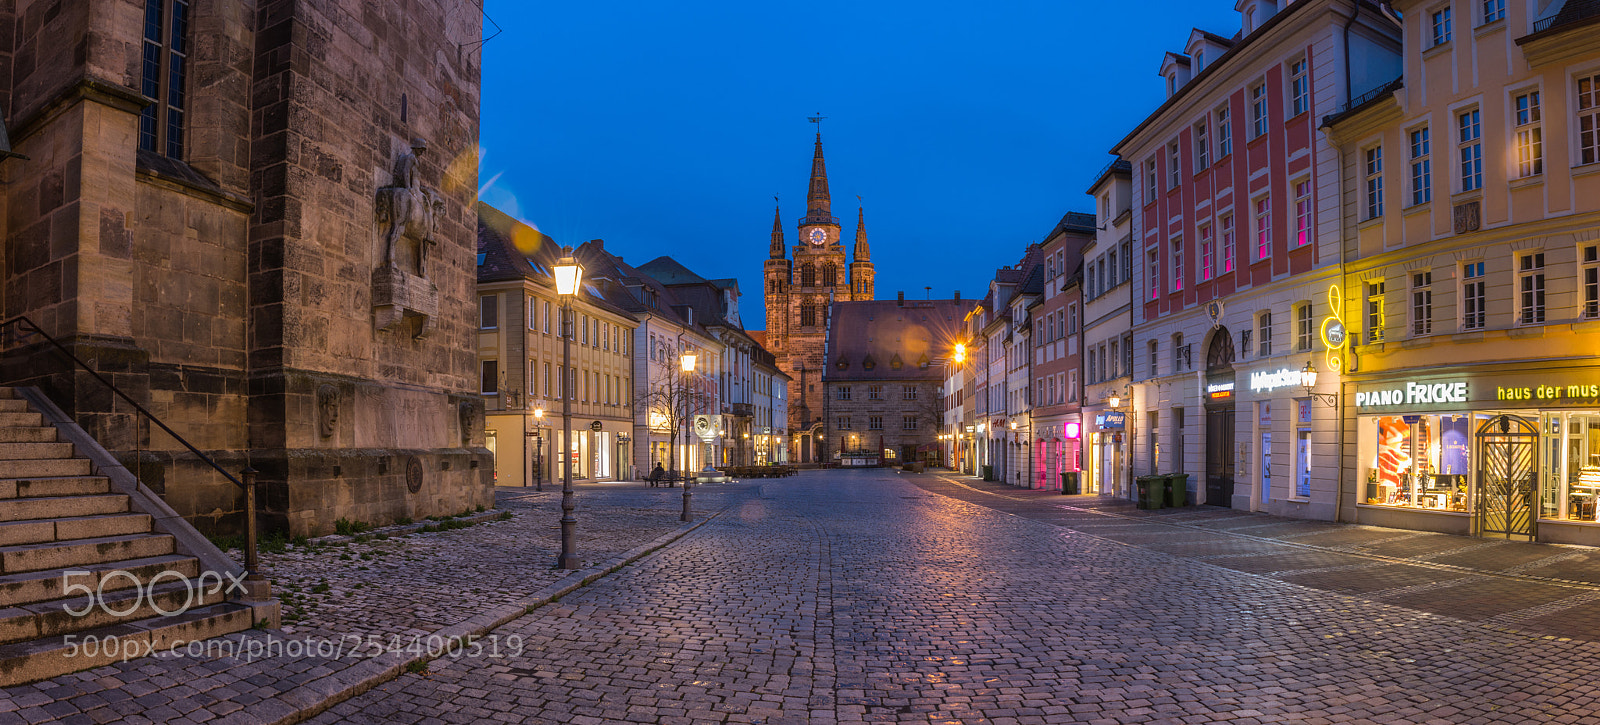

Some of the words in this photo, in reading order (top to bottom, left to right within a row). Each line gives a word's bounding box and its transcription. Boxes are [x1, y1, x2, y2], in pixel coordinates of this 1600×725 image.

[1356, 390, 1403, 406] PIANO
[1406, 382, 1466, 404] FRICKE
[1497, 386, 1531, 400] haus
[1536, 384, 1562, 399] der
